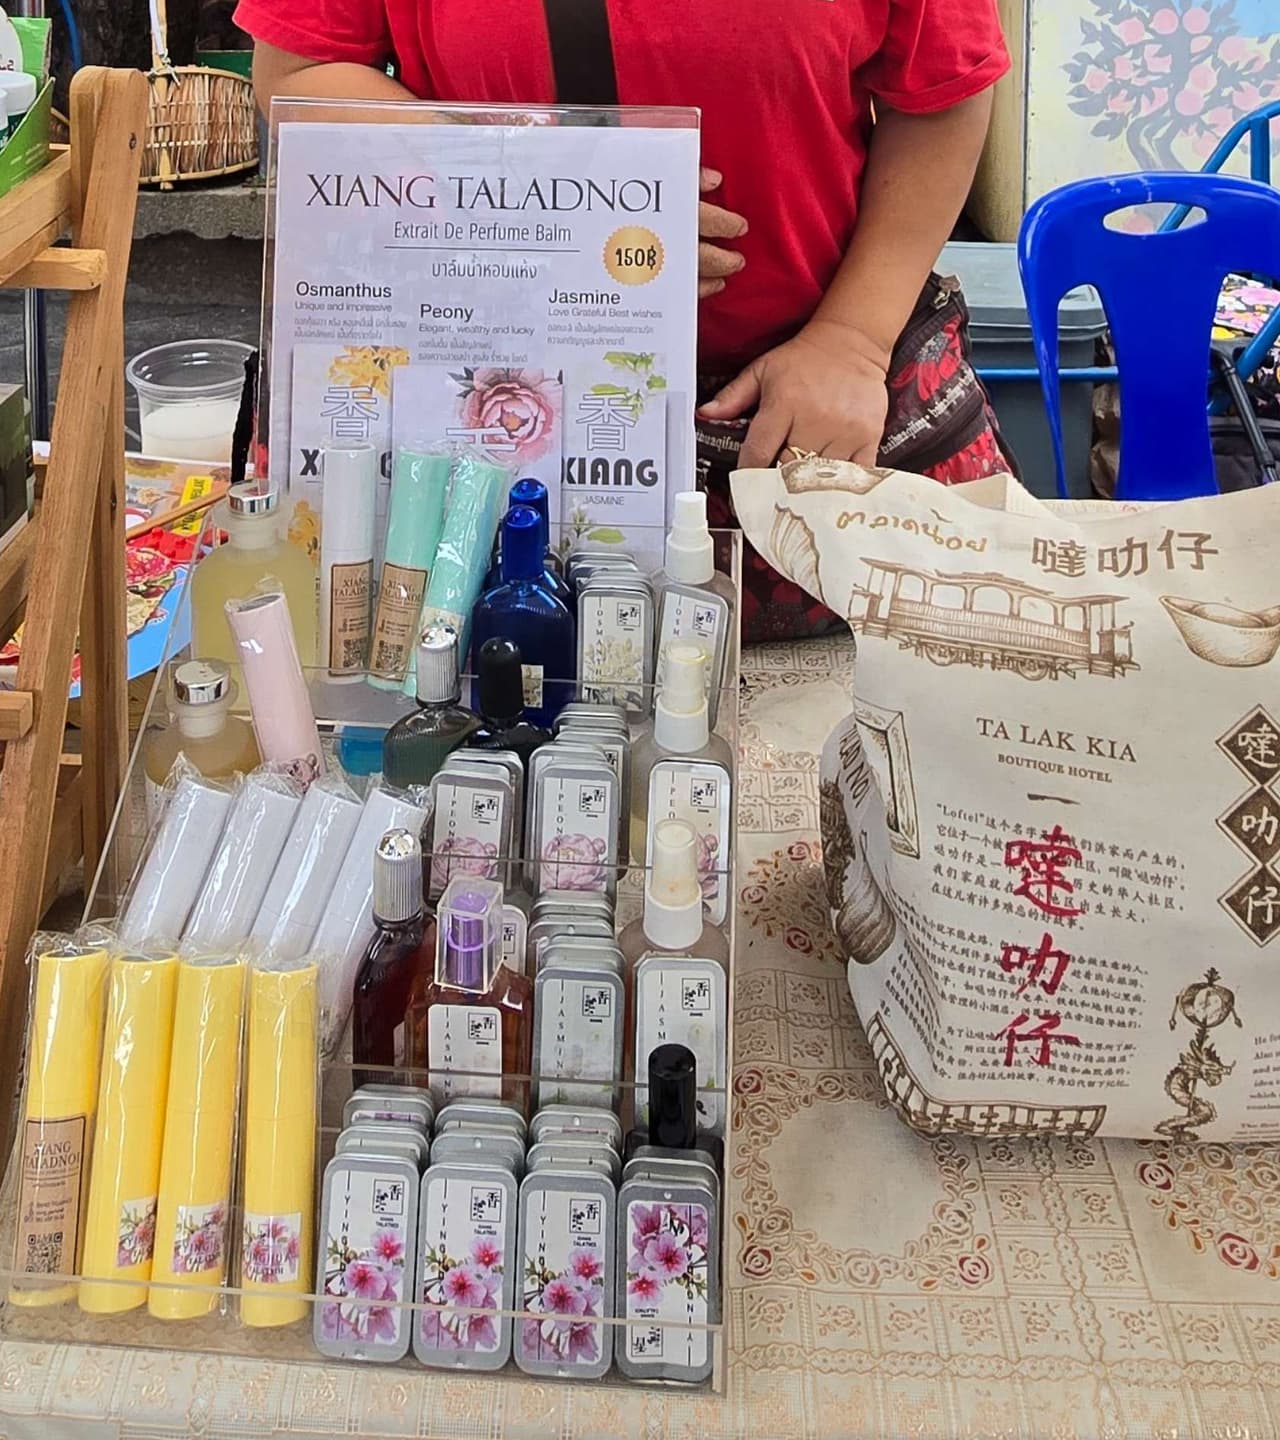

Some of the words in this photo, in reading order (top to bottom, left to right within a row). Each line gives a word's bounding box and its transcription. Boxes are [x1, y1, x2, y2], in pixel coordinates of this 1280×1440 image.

[307, 173, 437, 209] XIANG
[448, 175, 663, 213] TALADNOI
[393, 221, 439, 241] Extrait
[444, 222, 464, 241] De
[468, 222, 531, 243] Perfume
[535, 223, 572, 242] Balm
[295, 281, 393, 300] Osmanthus
[548, 288, 621, 306] Jasmine
[294, 301, 325, 313] Unique
[327, 301, 344, 311] and
[419, 303, 474, 322] Peony
[548, 307, 570, 317] Love
[572, 308, 607, 318] Grateful
[609, 309, 629, 318] Best
[631, 310, 663, 319] wishes
[456, 325, 489, 336] wealthy
[492, 326, 509, 335] and
[511, 325, 535, 337] lucky
[320, 384, 380, 441] 香
[576, 391, 638, 452] 香
[582, 495, 625, 506] JASMINE
[976, 716, 1010, 741] TA
[1018, 720, 1075, 753] LAK
[1085, 729, 1138, 763] KIA
[997, 752, 1065, 775] BOUTIQUE
[1068, 764, 1113, 784] HOTEL
[1254, 1035, 1268, 1046] He
